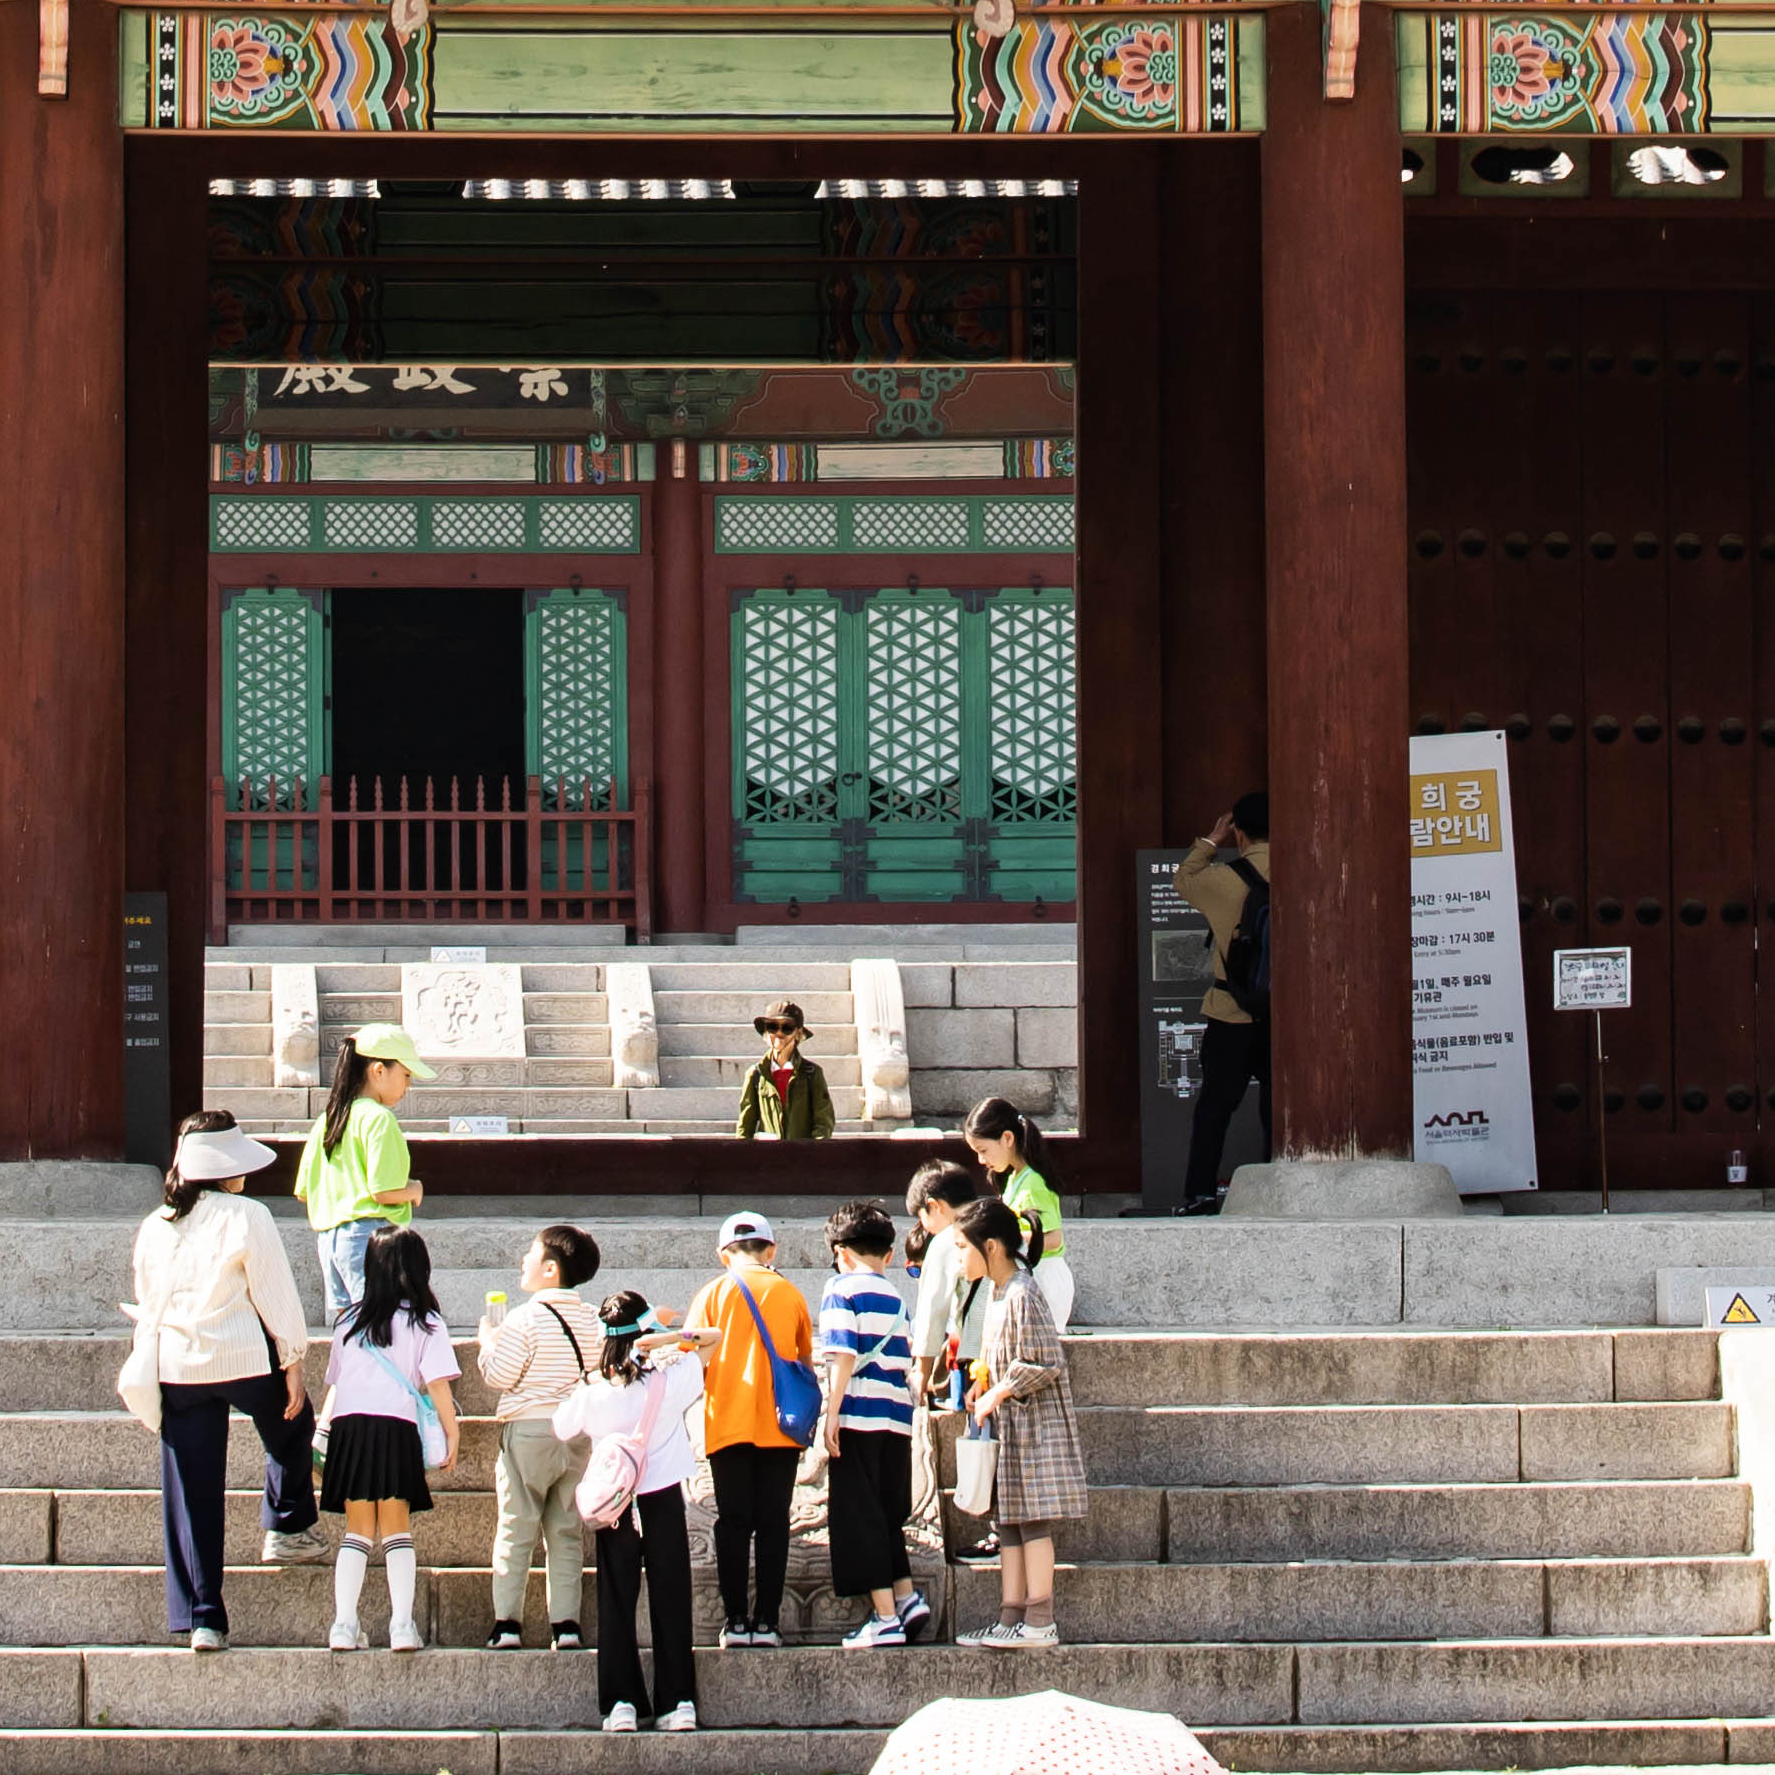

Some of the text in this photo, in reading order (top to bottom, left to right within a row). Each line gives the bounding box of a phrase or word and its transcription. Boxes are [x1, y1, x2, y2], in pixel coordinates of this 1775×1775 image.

[1420, 779, 1482, 812] 희궁
[1410, 813, 1490, 847] 람안내
[1411, 894, 1435, 906] 시간
[1411, 935, 1438, 948] 장마감
[1414, 991, 1442, 1003] 기휴관
